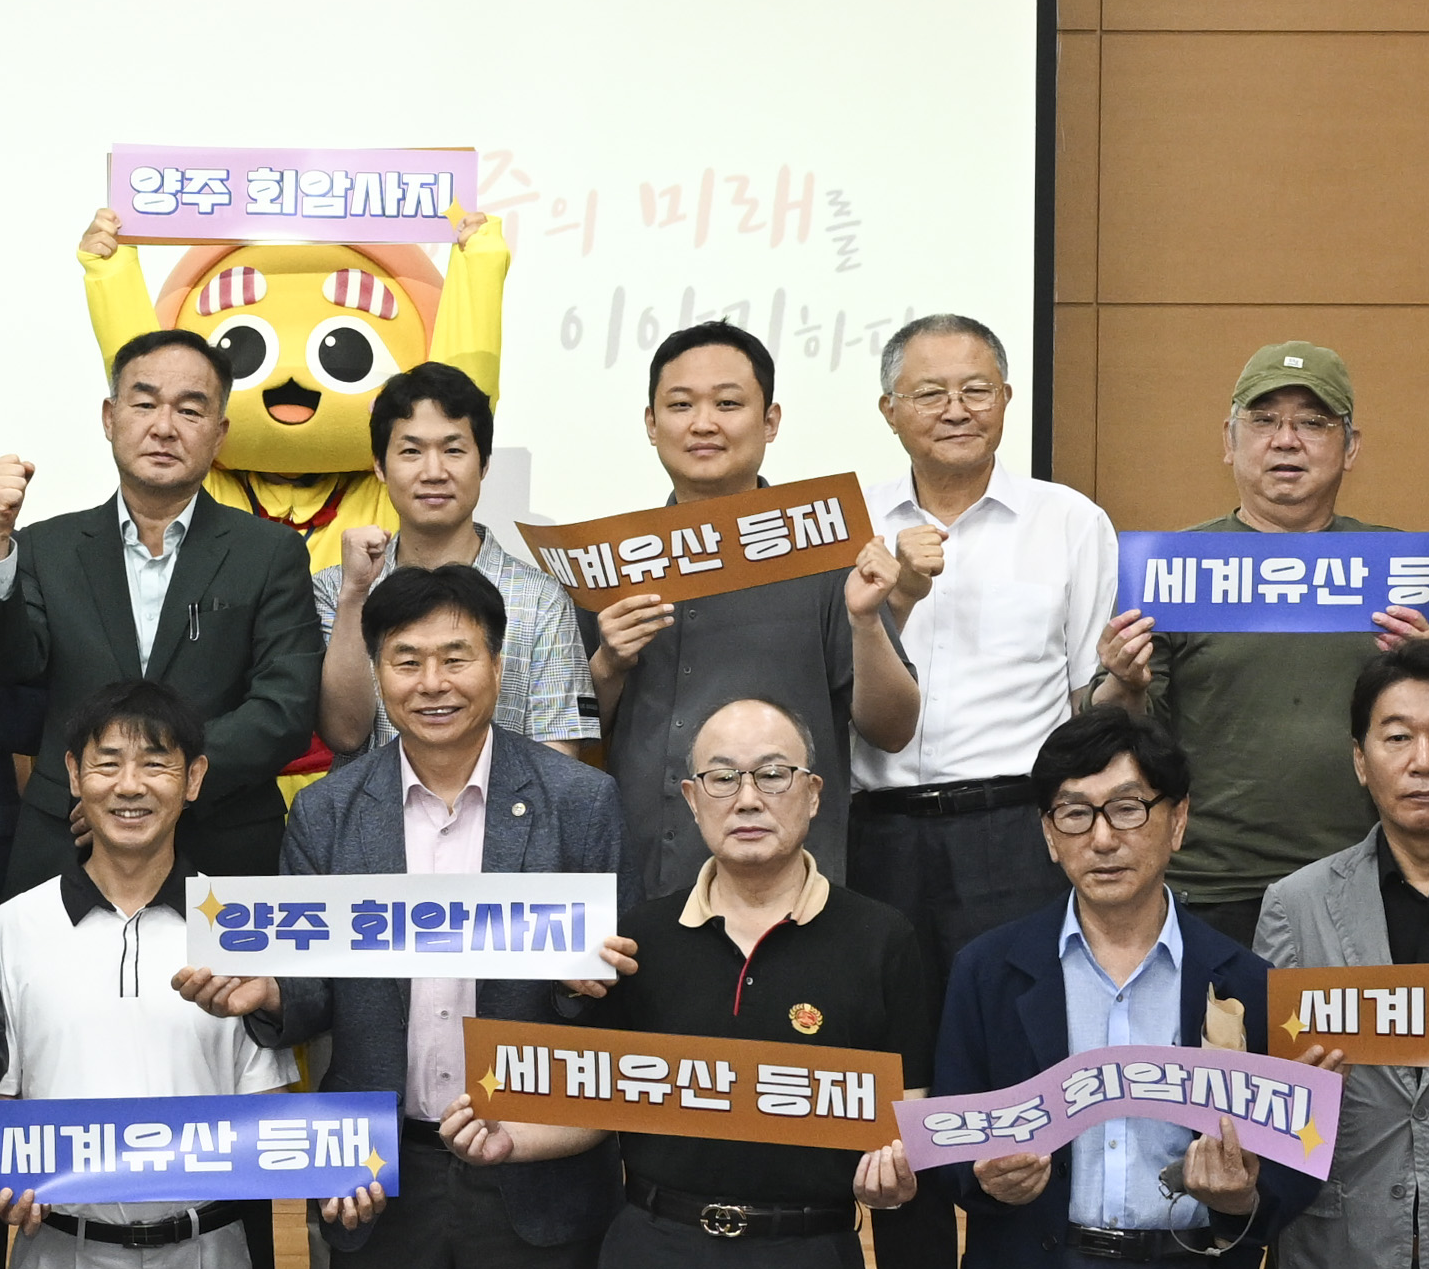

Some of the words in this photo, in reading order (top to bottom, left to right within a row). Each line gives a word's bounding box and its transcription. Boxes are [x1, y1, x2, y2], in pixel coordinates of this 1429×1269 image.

[129, 164, 234, 219] 양주
[244, 165, 455, 221] 회암사지
[639, 163, 863, 273] 미래를
[539, 523, 724, 591] 세계유산
[737, 497, 849, 562] 등재
[1143, 555, 1367, 606] 세계유산
[214, 901, 331, 952] 양주
[349, 899, 587, 954] 회암사지
[494, 1043, 738, 1112] 세계유산
[753, 1064, 878, 1121] 등재
[923, 1098, 1054, 1149] 양주
[1061, 1063, 1315, 1142] 회암사지
[0, 1121, 240, 1177] 세계유산
[255, 1117, 372, 1172] 등재
